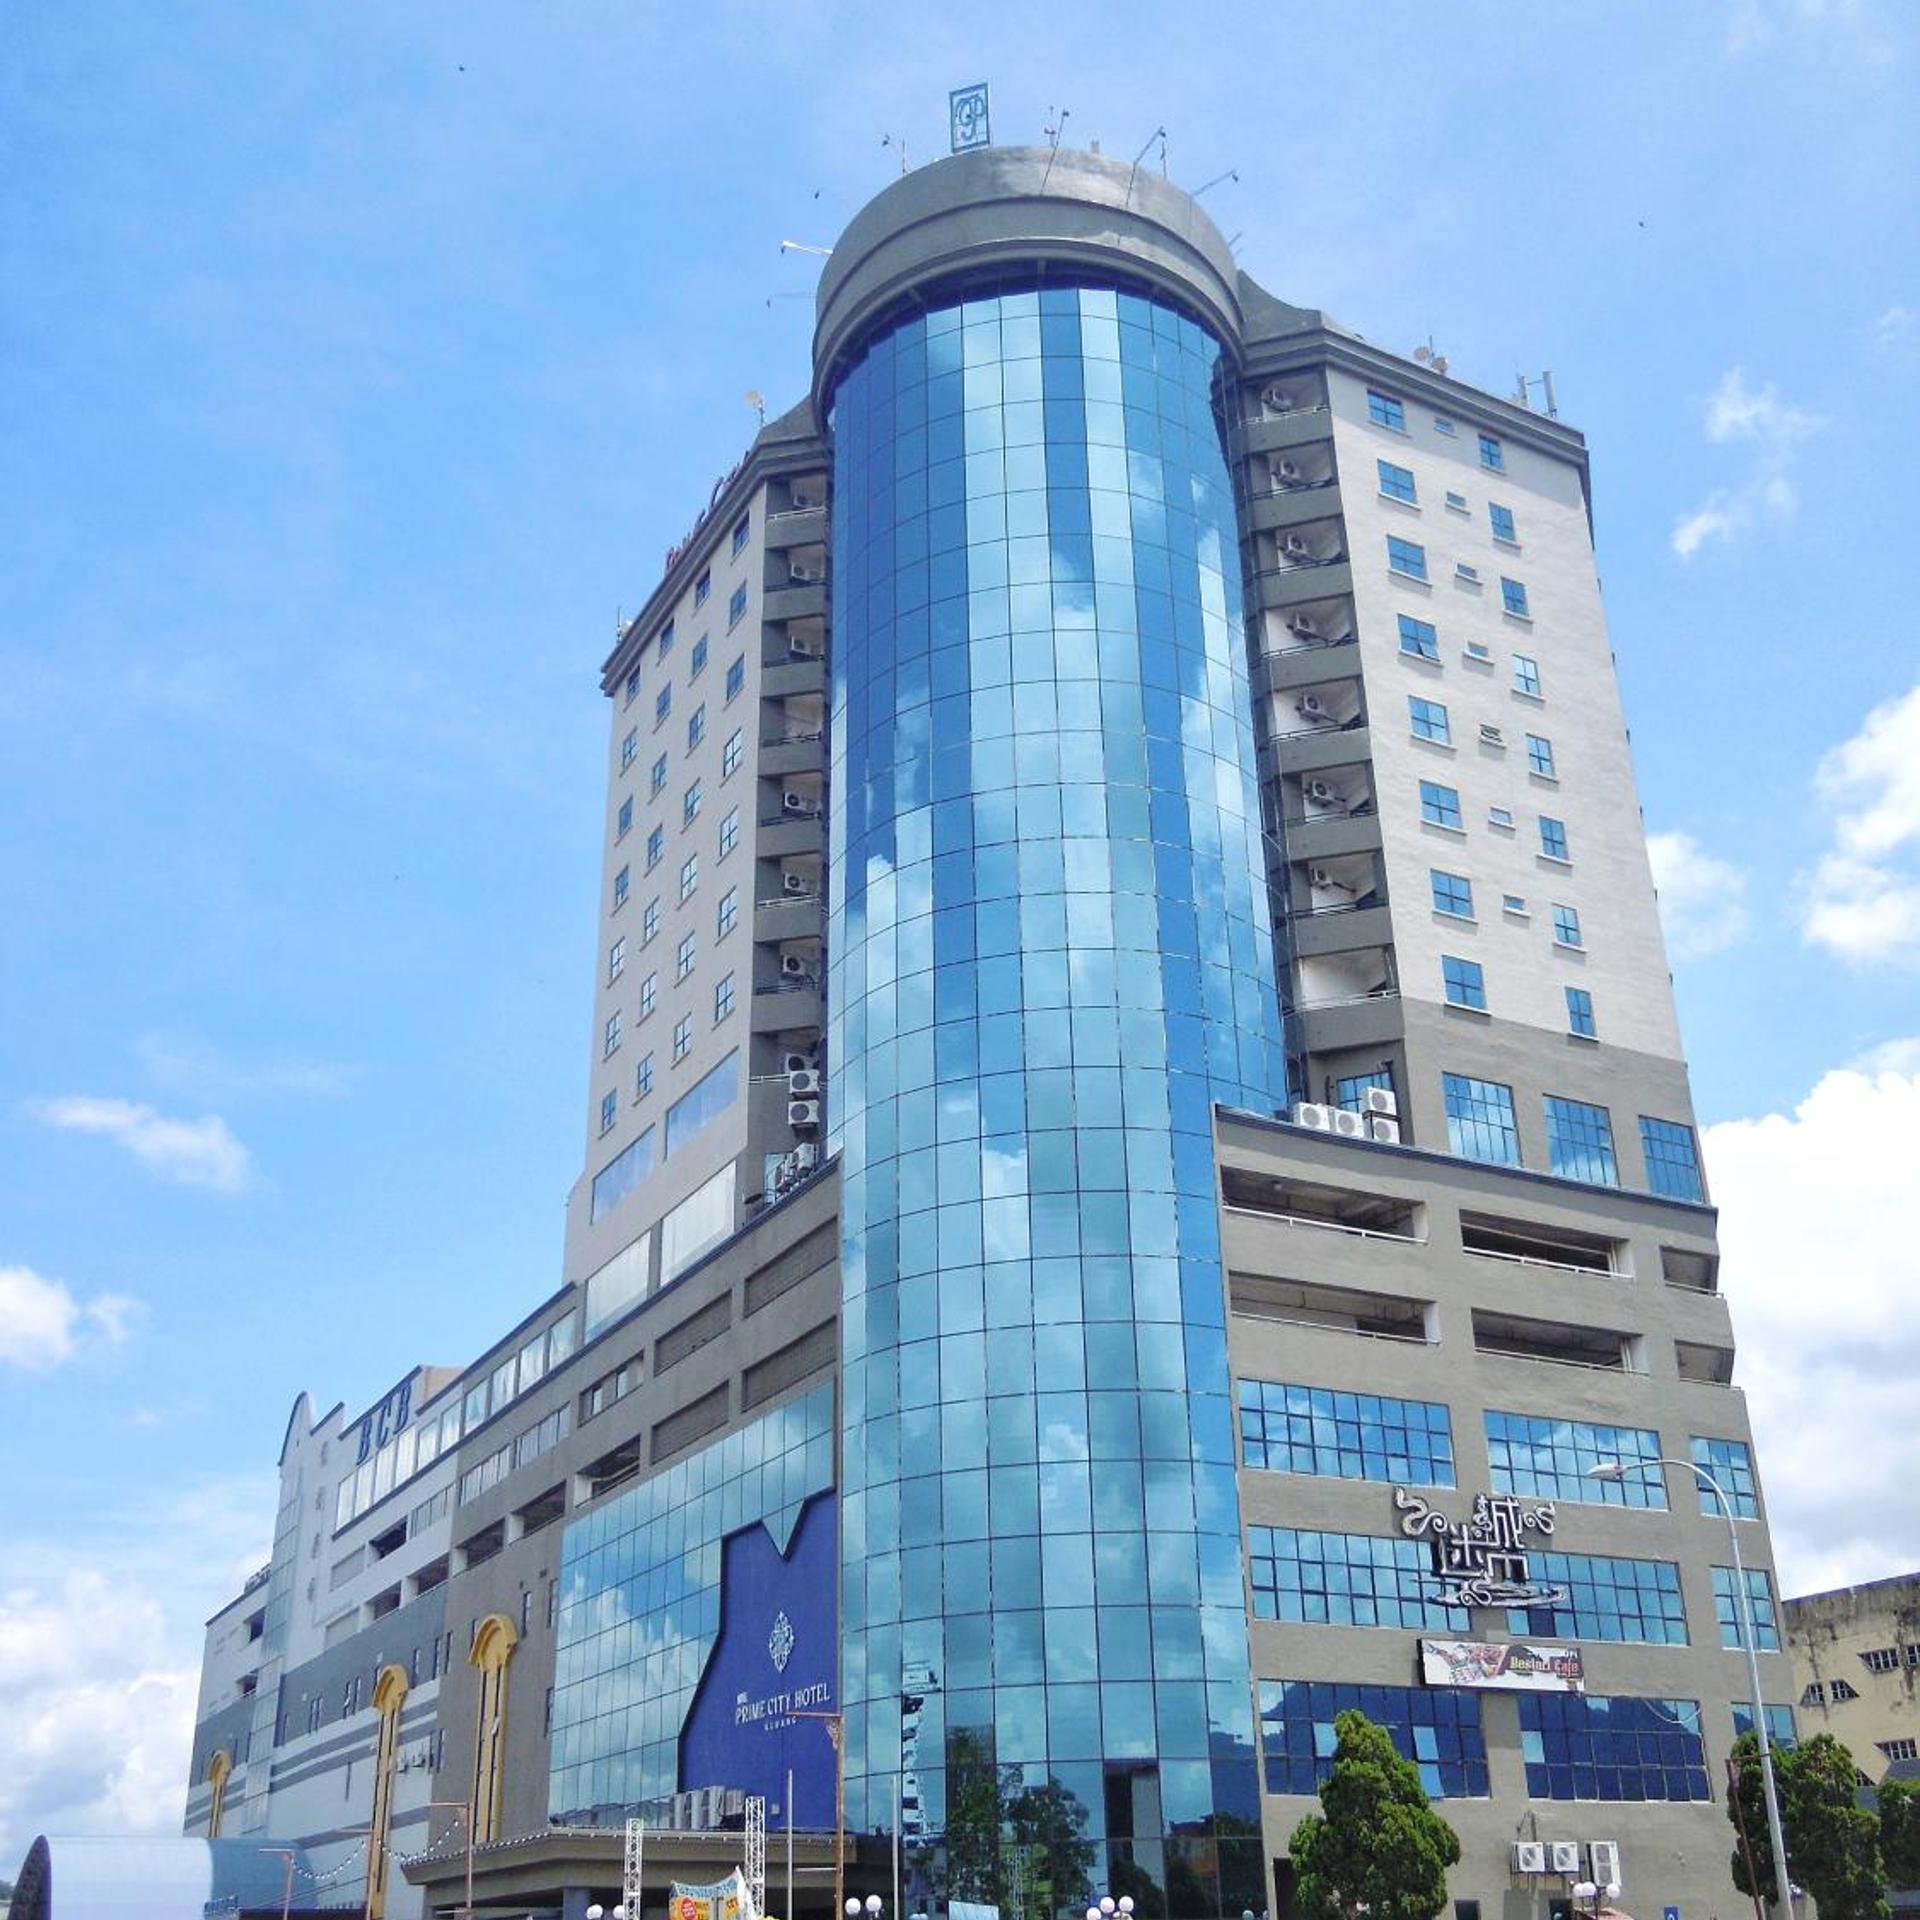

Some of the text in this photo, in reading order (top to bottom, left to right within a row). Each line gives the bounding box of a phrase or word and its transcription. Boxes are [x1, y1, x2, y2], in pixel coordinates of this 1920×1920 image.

[356, 1381, 412, 1466] BCB
[735, 1700, 766, 1727] PRIME
[767, 1693, 791, 1715] CITY
[795, 1682, 830, 1709] HOTEL
